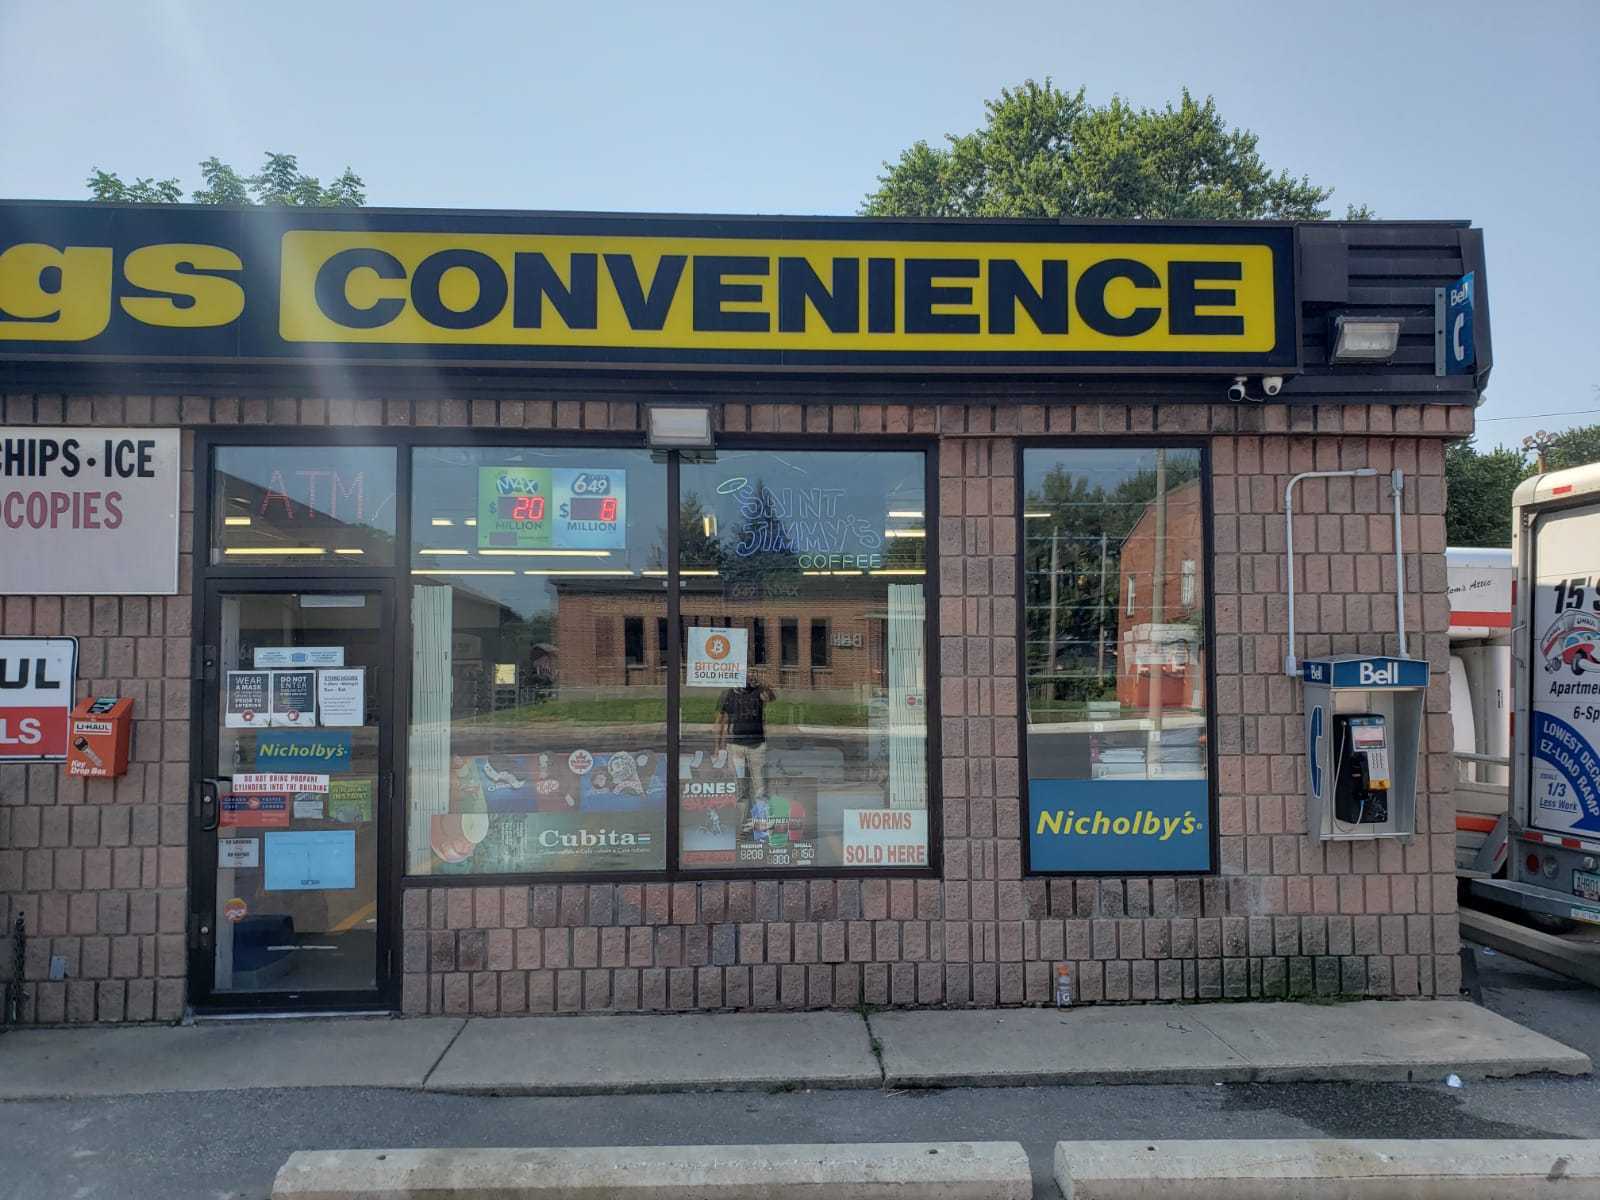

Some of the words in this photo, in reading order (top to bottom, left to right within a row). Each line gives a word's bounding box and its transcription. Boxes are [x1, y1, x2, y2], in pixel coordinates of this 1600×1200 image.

[314, 247, 1246, 337] CONVENIENCE
[1450, 282, 1469, 306] Bell
[0, 438, 81, 478] HIPS
[104, 439, 156, 478] ICE
[259, 469, 365, 520] ATM
[733, 484, 847, 520] SAINT
[0, 491, 123, 530] COPIES
[512, 496, 544, 521] 20
[560, 503, 569, 518] $
[496, 521, 543, 530] MILLION
[567, 521, 617, 531] MILLION
[736, 515, 881, 556] JIMMY'S
[798, 553, 881, 569] COFFEE
[0, 658, 60, 689] UL
[694, 662, 740, 672] BITCOIN
[694, 671, 716, 680] SOLD
[718, 672, 739, 680] HERE
[1311, 664, 1323, 680] Bell
[1359, 661, 1399, 685] Bell
[235, 676, 262, 685] WEAR
[1550, 680, 1600, 697] Apartme
[0, 718, 42, 745] LS
[1543, 720, 1584, 754] LOWEST
[259, 742, 345, 760] Nicholby's
[255, 775, 267, 783] NOT
[269, 775, 288, 783] BRING
[290, 775, 318, 783] PROPANE
[1540, 739, 1580, 777] EZ-LOAD
[1577, 775, 1600, 817] RAMP
[234, 784, 267, 792] CYLINDERS
[269, 784, 284, 792] INTO
[286, 784, 297, 792] THE
[299, 784, 327, 792] BUILDING
[682, 782, 736, 794] JONES
[1547, 781, 1567, 797] 1/3
[1558, 799, 1578, 811] Work
[858, 812, 912, 830] WORMS
[1036, 809, 1197, 841] Nicholby's
[538, 828, 636, 848] Cubita
[846, 845, 883, 864] SOLD
[887, 844, 925, 864] HERE
